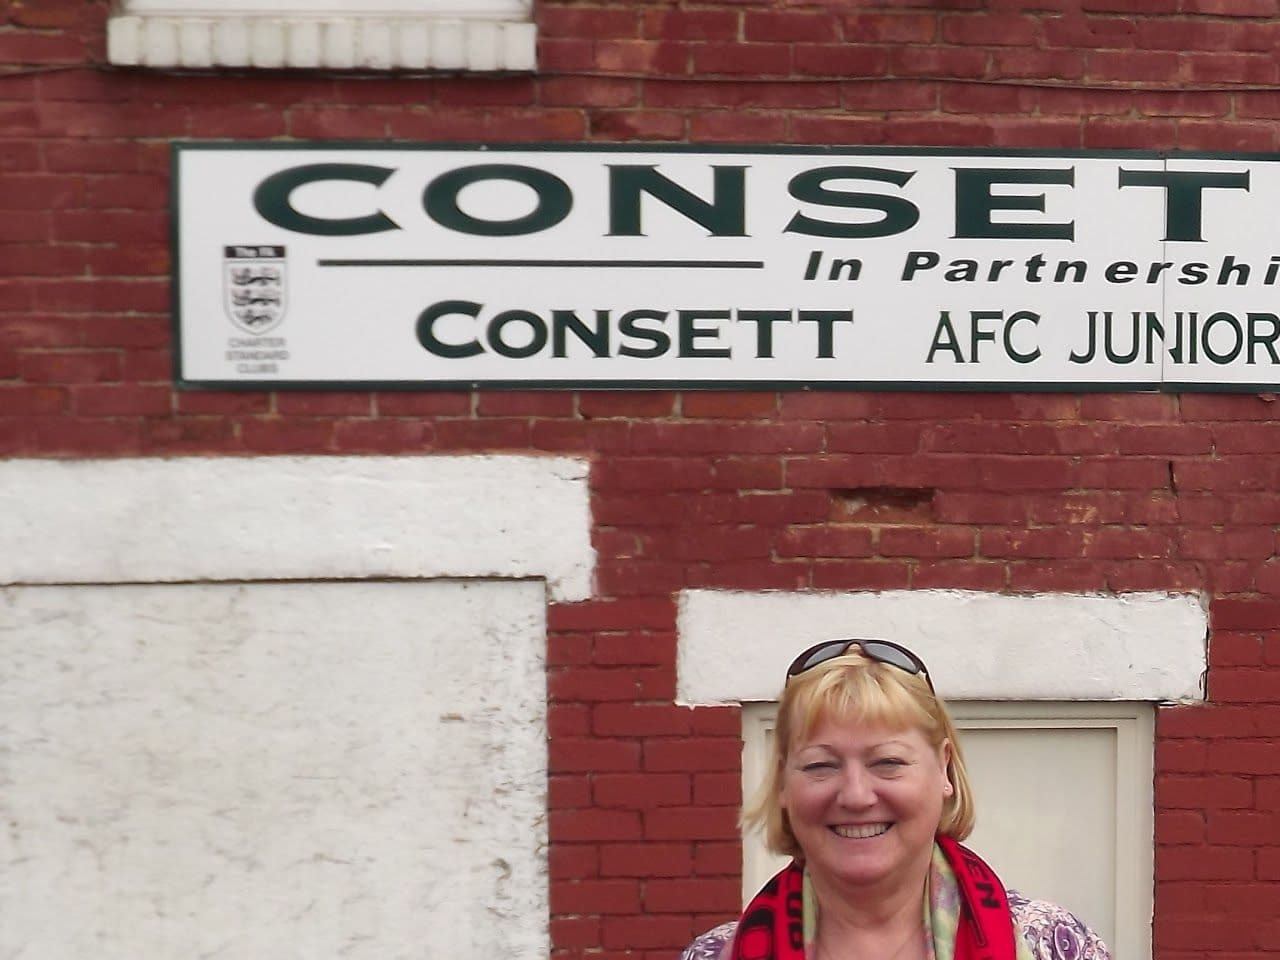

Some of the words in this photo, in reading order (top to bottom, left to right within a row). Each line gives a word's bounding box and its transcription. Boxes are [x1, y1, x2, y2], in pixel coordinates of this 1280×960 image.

[804, 250, 863, 281] In
[415, 300, 854, 359] CONSETT
[925, 310, 1042, 364] AFC
